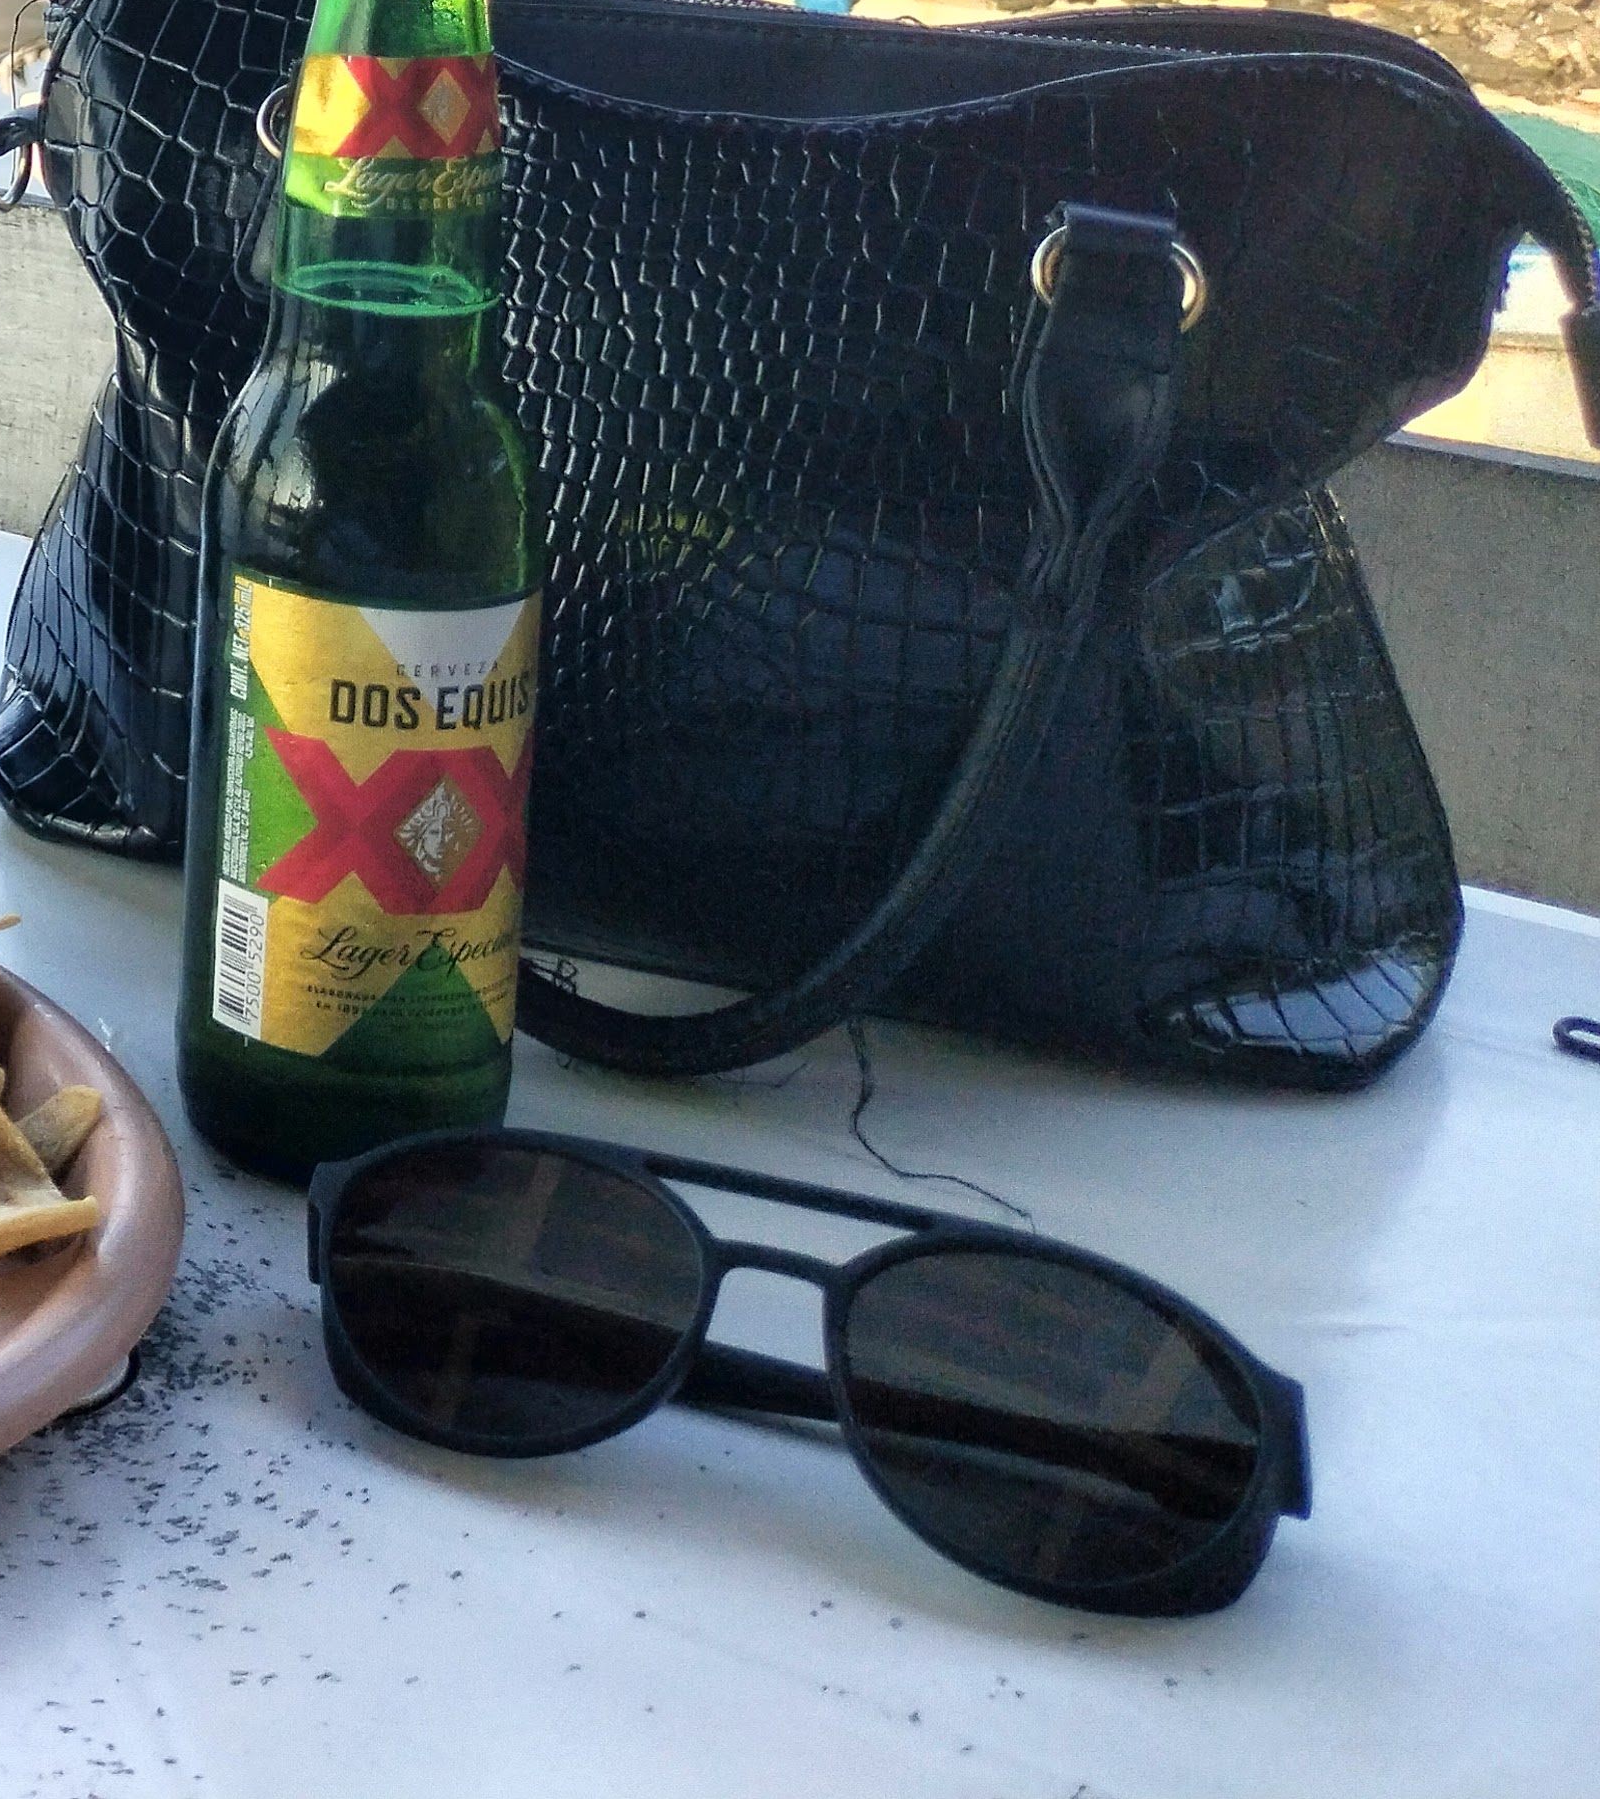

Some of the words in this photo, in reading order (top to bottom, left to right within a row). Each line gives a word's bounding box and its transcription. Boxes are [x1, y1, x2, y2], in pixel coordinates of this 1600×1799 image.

[234, 604, 251, 632] 325
[396, 659, 498, 678] CERVEZA
[330, 678, 422, 731] DOS
[435, 670, 530, 731] EQUIS
[249, 913, 265, 963] 5290
[300, 926, 411, 981] Lager
[245, 972, 262, 1020] 7500
